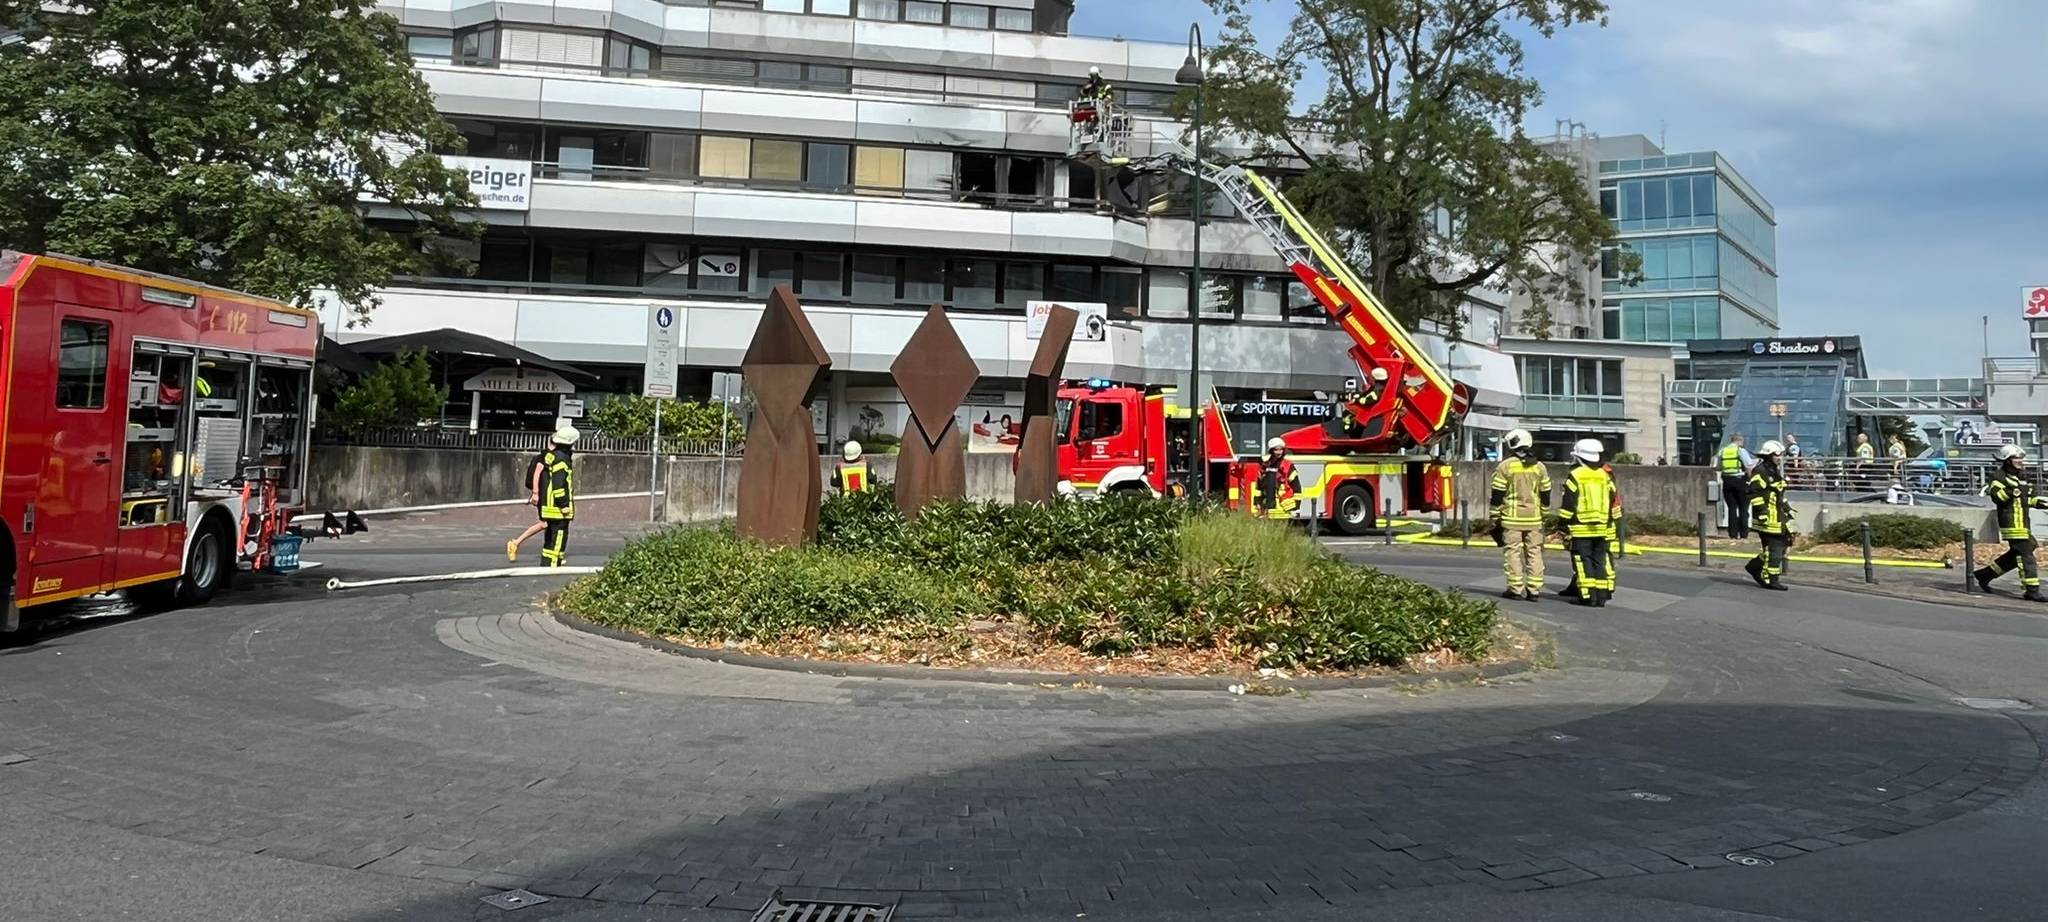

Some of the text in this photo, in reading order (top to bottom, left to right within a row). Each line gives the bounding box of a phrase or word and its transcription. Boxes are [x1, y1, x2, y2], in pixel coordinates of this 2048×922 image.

[470, 165, 526, 191] eiger
[1769, 341, 1819, 354] Shadow
[480, 379, 559, 392] MILLE LIRE
[1242, 402, 1330, 417] SPORTWETTEN
